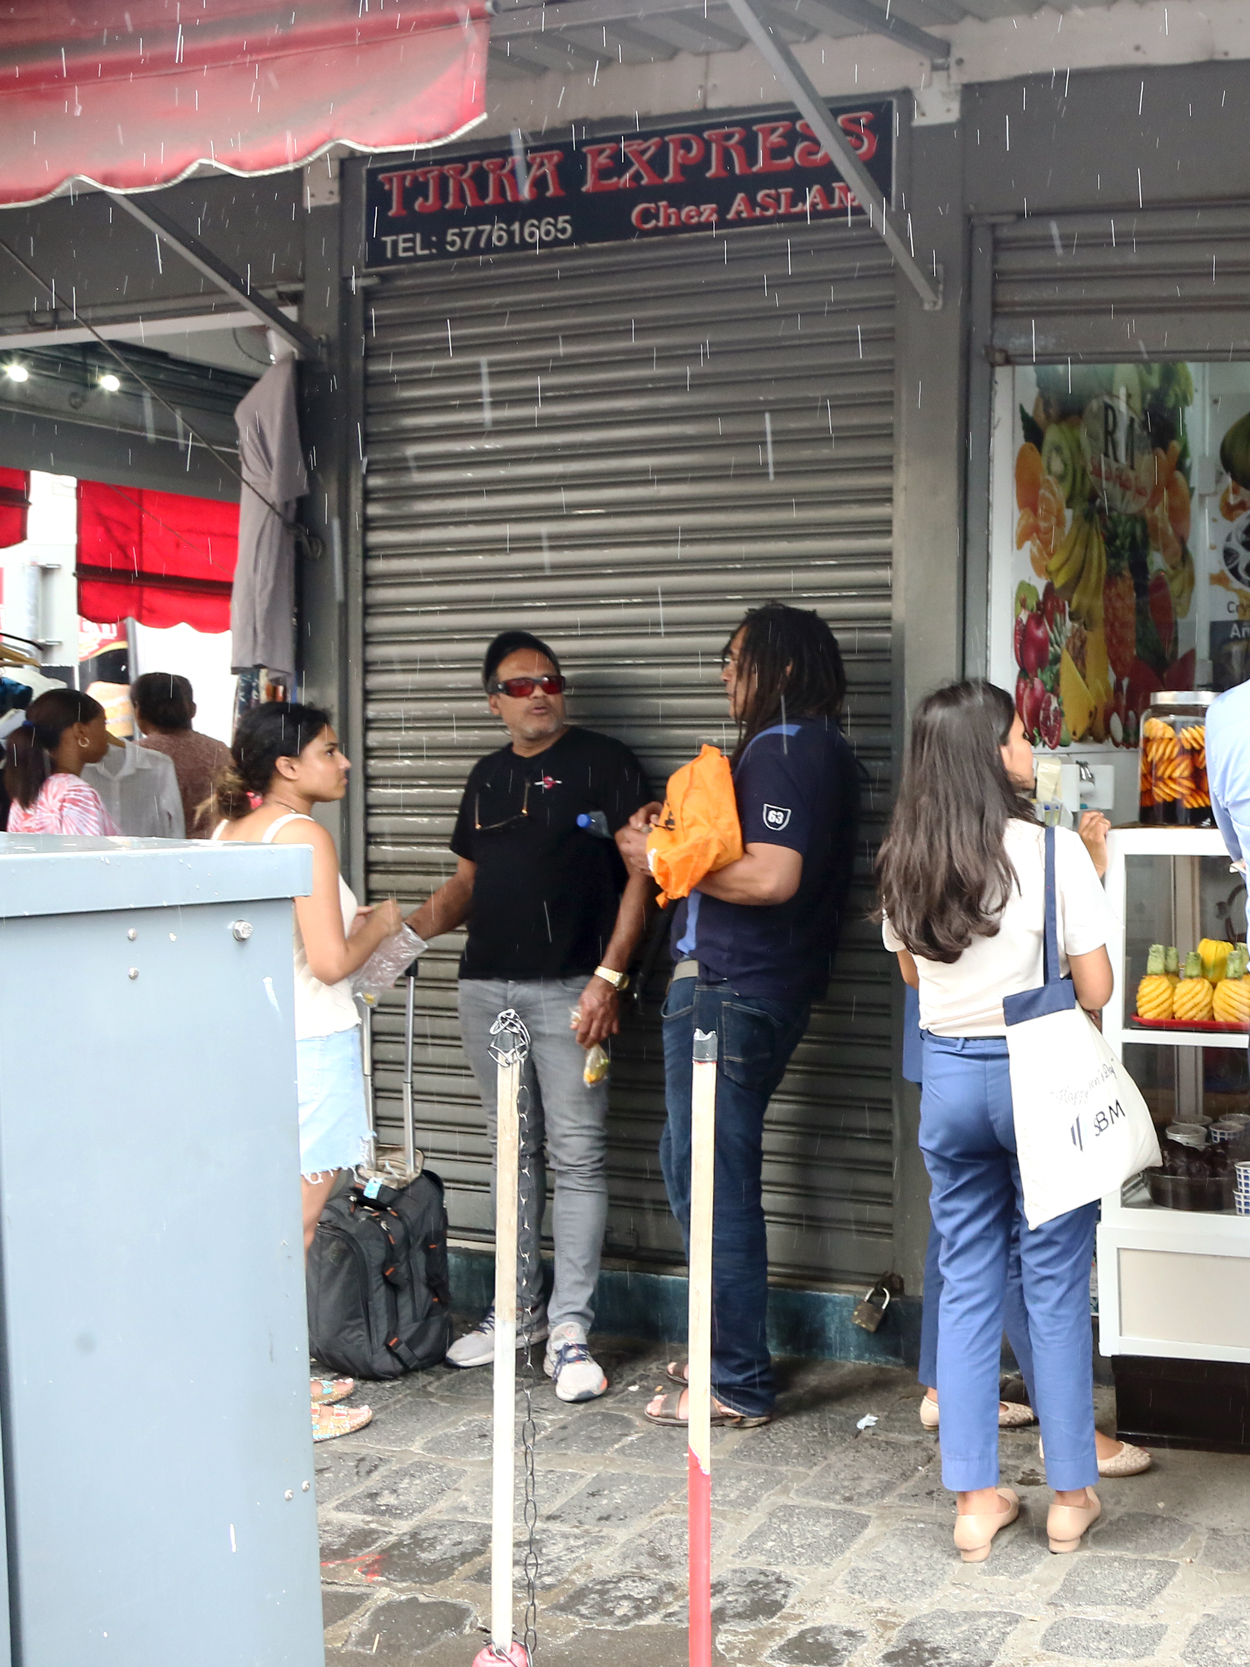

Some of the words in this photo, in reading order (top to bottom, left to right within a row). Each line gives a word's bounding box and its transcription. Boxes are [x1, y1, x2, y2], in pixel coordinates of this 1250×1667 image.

[377, 149, 566, 217] TIKKA
[580, 111, 877, 193] EXPRESS
[631, 201, 719, 230] Chez
[381, 233, 438, 259] TEL:
[445, 215, 573, 251] 57761665
[767, 809, 785, 825] 63
[1093, 1098, 1126, 1137] SBM
